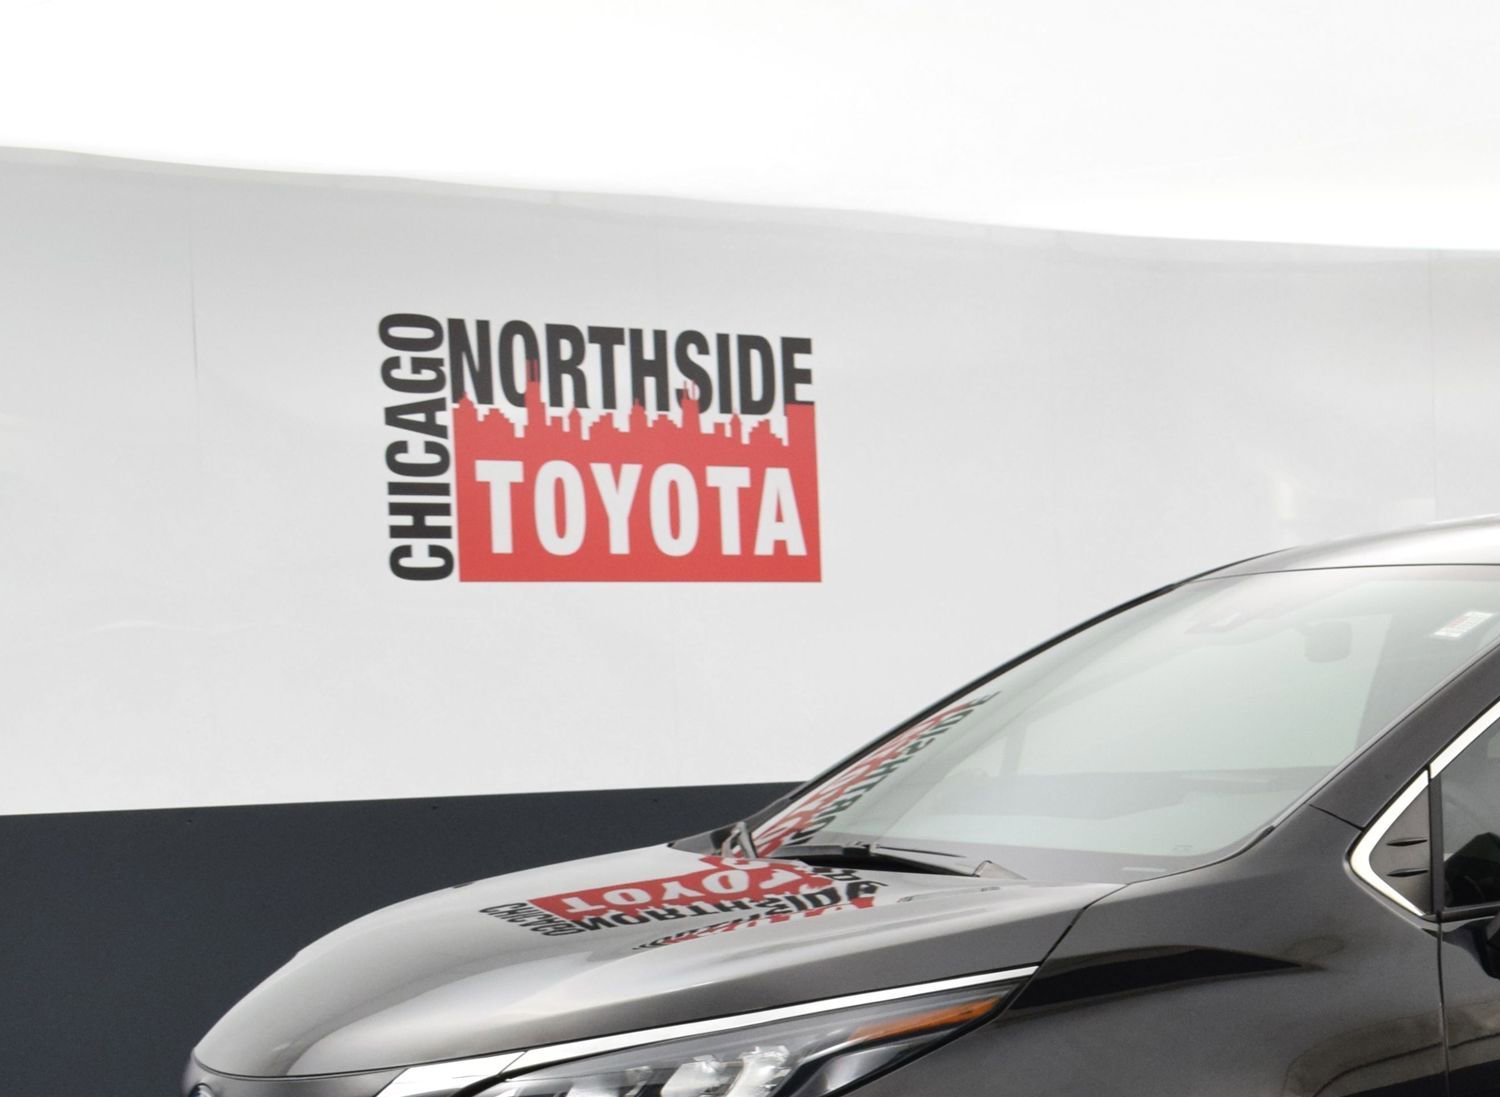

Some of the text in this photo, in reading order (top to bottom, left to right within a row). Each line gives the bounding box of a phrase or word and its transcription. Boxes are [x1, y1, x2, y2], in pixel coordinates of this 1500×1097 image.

[447, 317, 815, 416] NORTHSIDE
[378, 313, 455, 581] CHICAGO
[475, 460, 808, 557] TOYOTA
